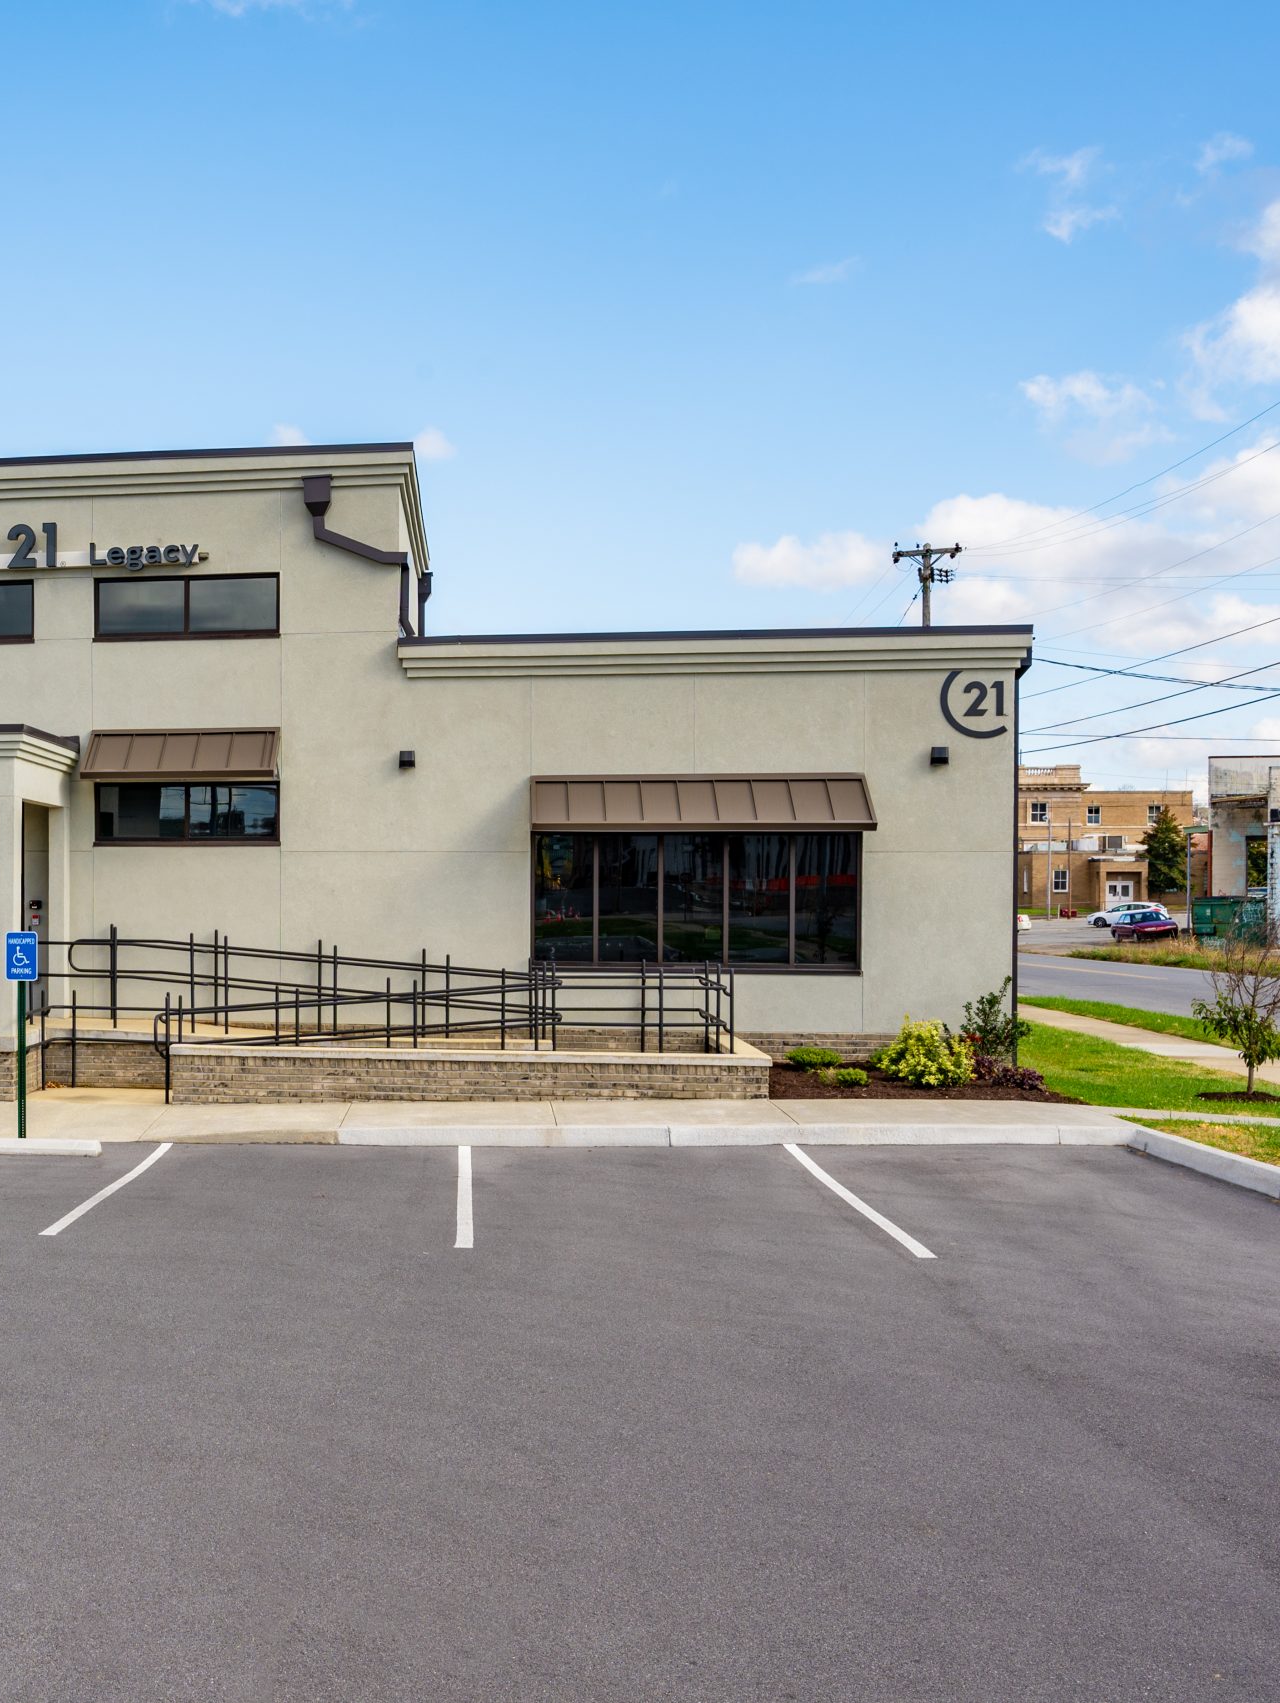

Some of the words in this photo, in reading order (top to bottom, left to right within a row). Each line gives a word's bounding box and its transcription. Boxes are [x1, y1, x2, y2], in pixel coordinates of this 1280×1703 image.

[7, 522, 57, 569] 21
[90, 543, 198, 571] Legacy
[8, 937, 35, 945] HANDICAPPED
[11, 967, 32, 975] PARKING
